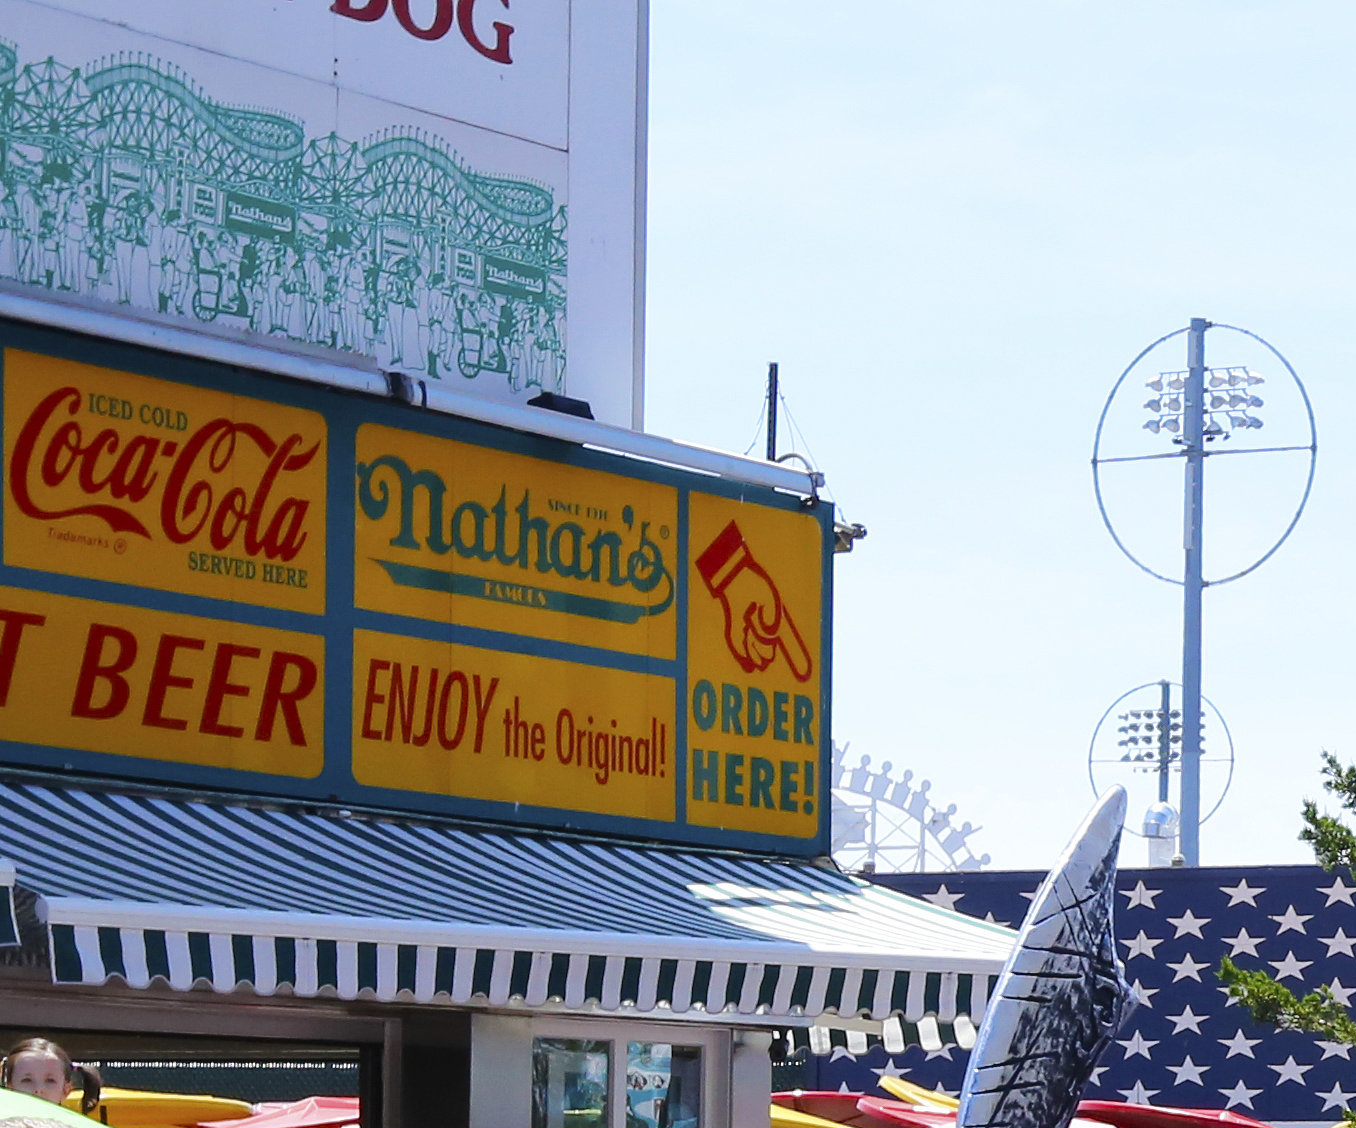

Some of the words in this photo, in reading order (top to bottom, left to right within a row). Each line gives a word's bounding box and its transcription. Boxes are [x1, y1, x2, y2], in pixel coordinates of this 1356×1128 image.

[330, 0, 514, 64] OG
[88, 393, 132, 420] ICED
[140, 404, 188, 431] COLD
[10, 387, 321, 562] Coca-Cola
[48, 527, 109, 549] Trademarks
[356, 455, 672, 592] Nathan's
[188, 551, 256, 579] SERVED
[263, 564, 308, 588] HERE
[71, 623, 318, 747] BEER
[692, 679, 815, 746] ORDER
[361, 658, 499, 754] ENJOY
[503, 696, 545, 762] the
[555, 708, 666, 785] Original!
[692, 749, 815, 816] HERE!
